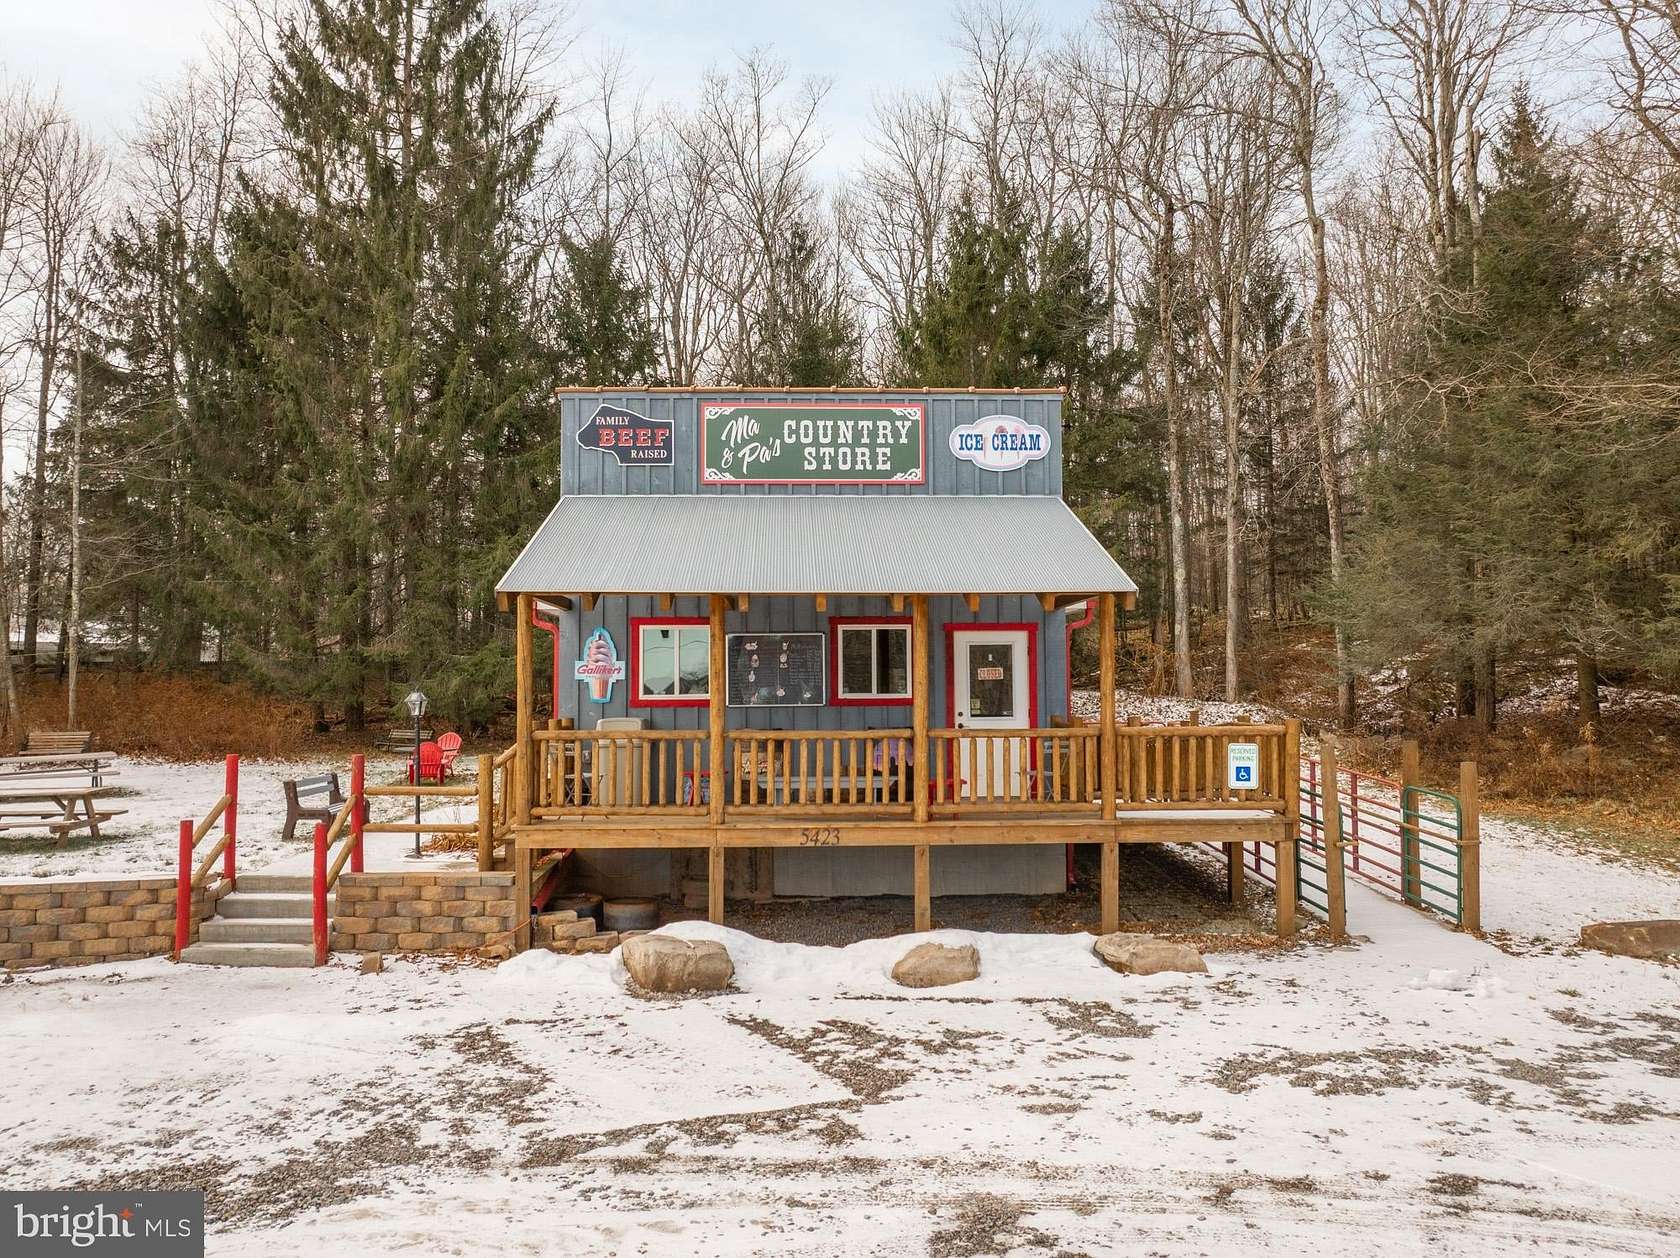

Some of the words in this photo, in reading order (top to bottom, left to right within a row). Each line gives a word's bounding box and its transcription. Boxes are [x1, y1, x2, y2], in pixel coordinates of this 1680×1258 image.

[595, 416, 630, 425] FAMILY
[598, 428, 670, 447] BEEF
[720, 415, 761, 448] Ma
[783, 419, 913, 444] COUNTRY
[958, 433, 984, 451] ICE
[991, 433, 1042, 451] CREAM
[631, 449, 667, 459] RAISED
[720, 447, 735, 469] &
[737, 437, 782, 475] Pa's
[803, 447, 892, 471] STORE
[799, 828, 840, 846] 5423
